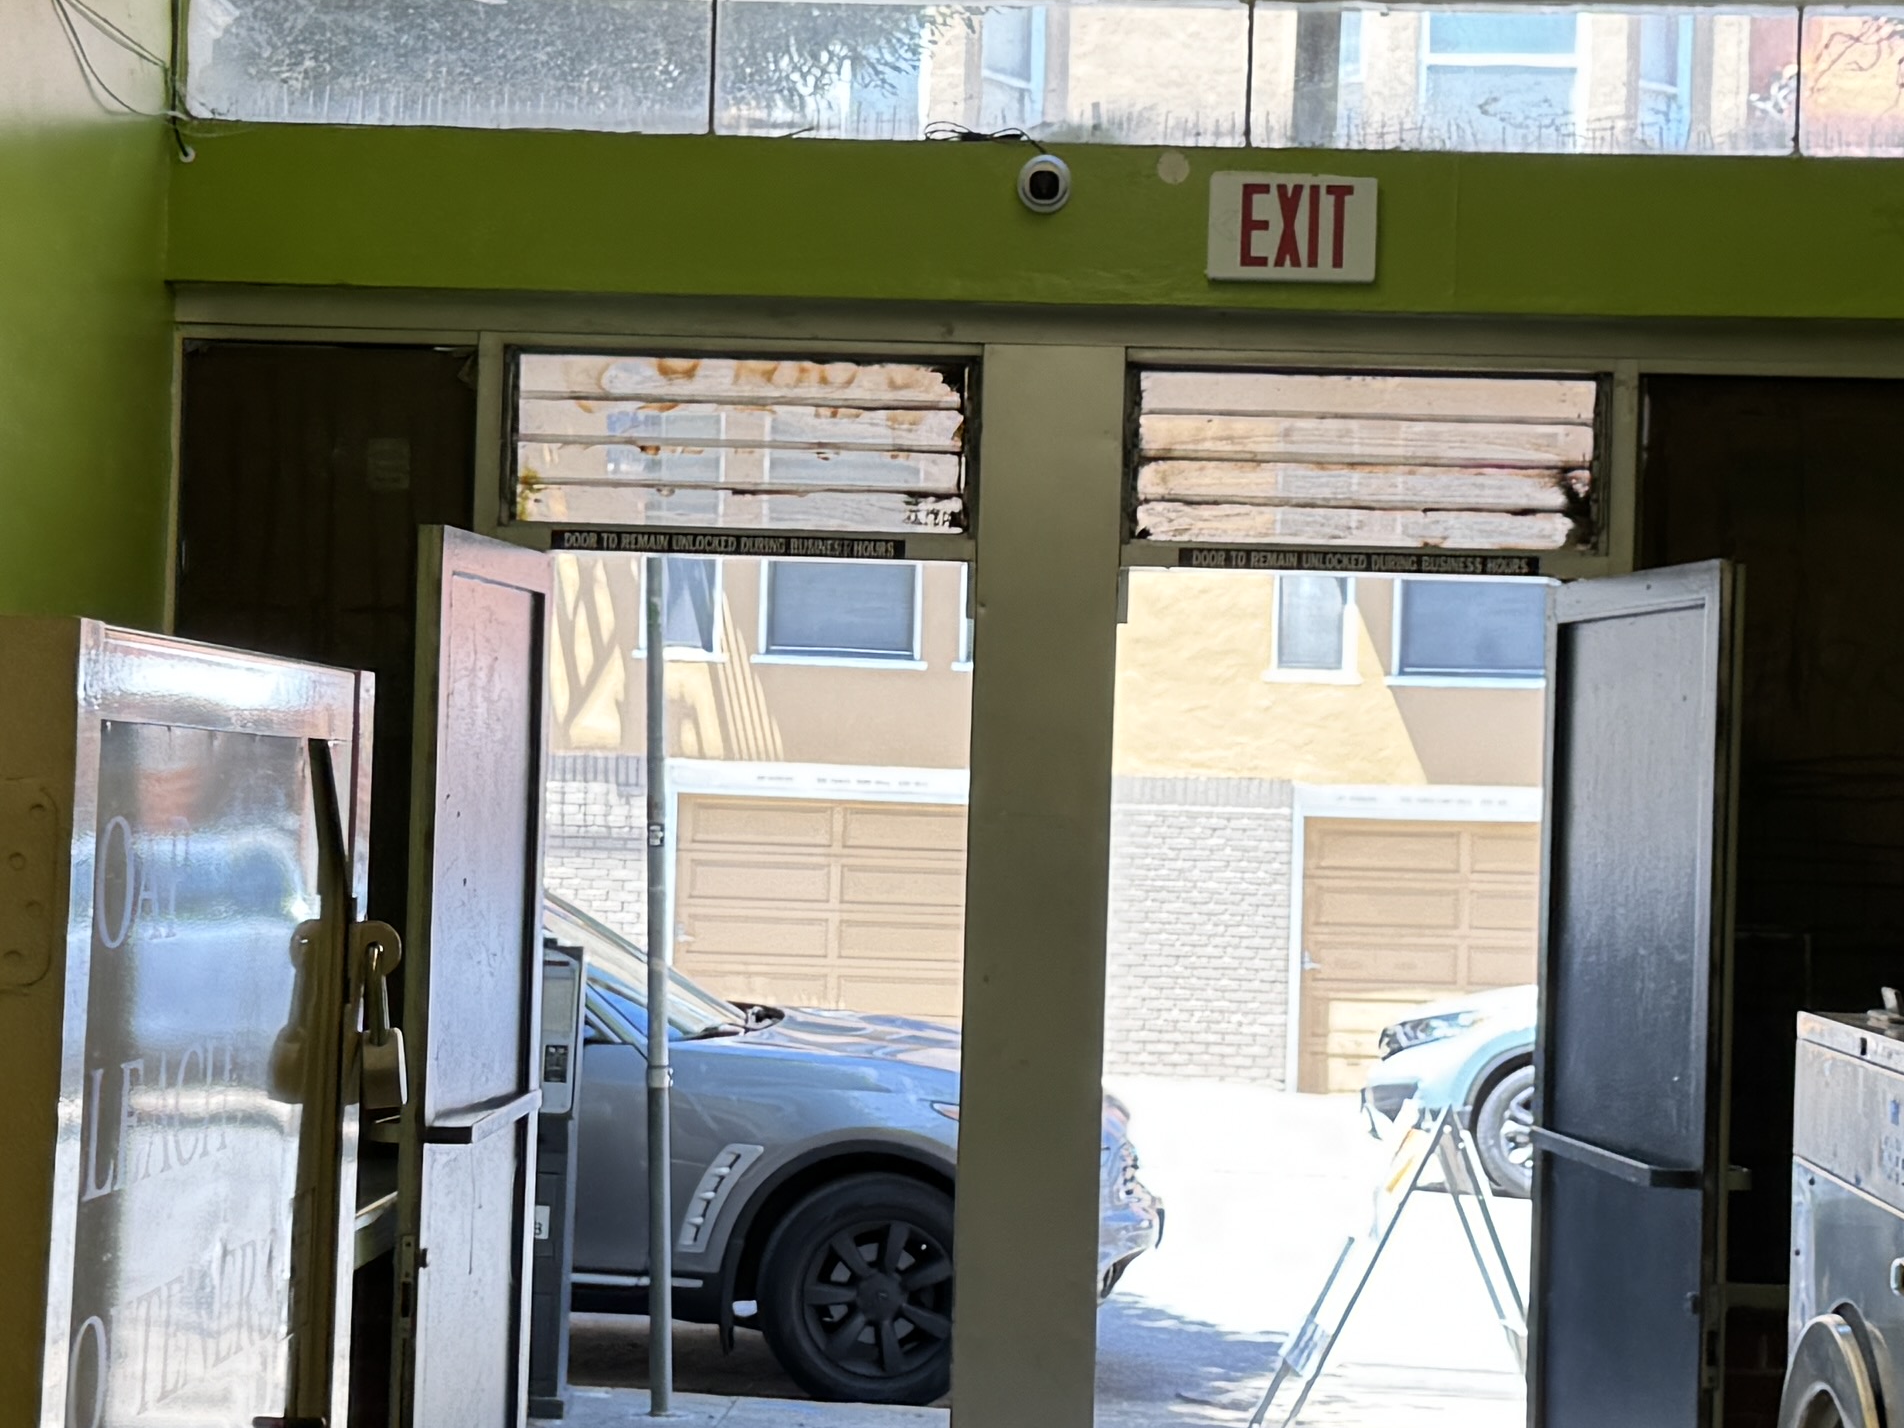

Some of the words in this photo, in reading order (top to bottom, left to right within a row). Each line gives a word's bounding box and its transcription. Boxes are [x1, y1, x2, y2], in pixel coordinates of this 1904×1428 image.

[1240, 183, 1355, 269] EXIT
[564, 532, 598, 548] DOOR
[601, 533, 618, 549] TO
[621, 534, 669, 550] REMAIN
[672, 535, 737, 552] UNLOCKED
[740, 537, 786, 553] DURING
[853, 540, 895, 557] HOURS
[1192, 550, 1226, 566] DOOR
[1230, 551, 1247, 567] TO
[1250, 552, 1298, 568] REMAIN
[1302, 553, 1367, 570] UNLOCKED
[1371, 555, 1418, 571] DURING
[1422, 556, 1482, 572] BUSINESS
[1486, 558, 1530, 574] HOURS
